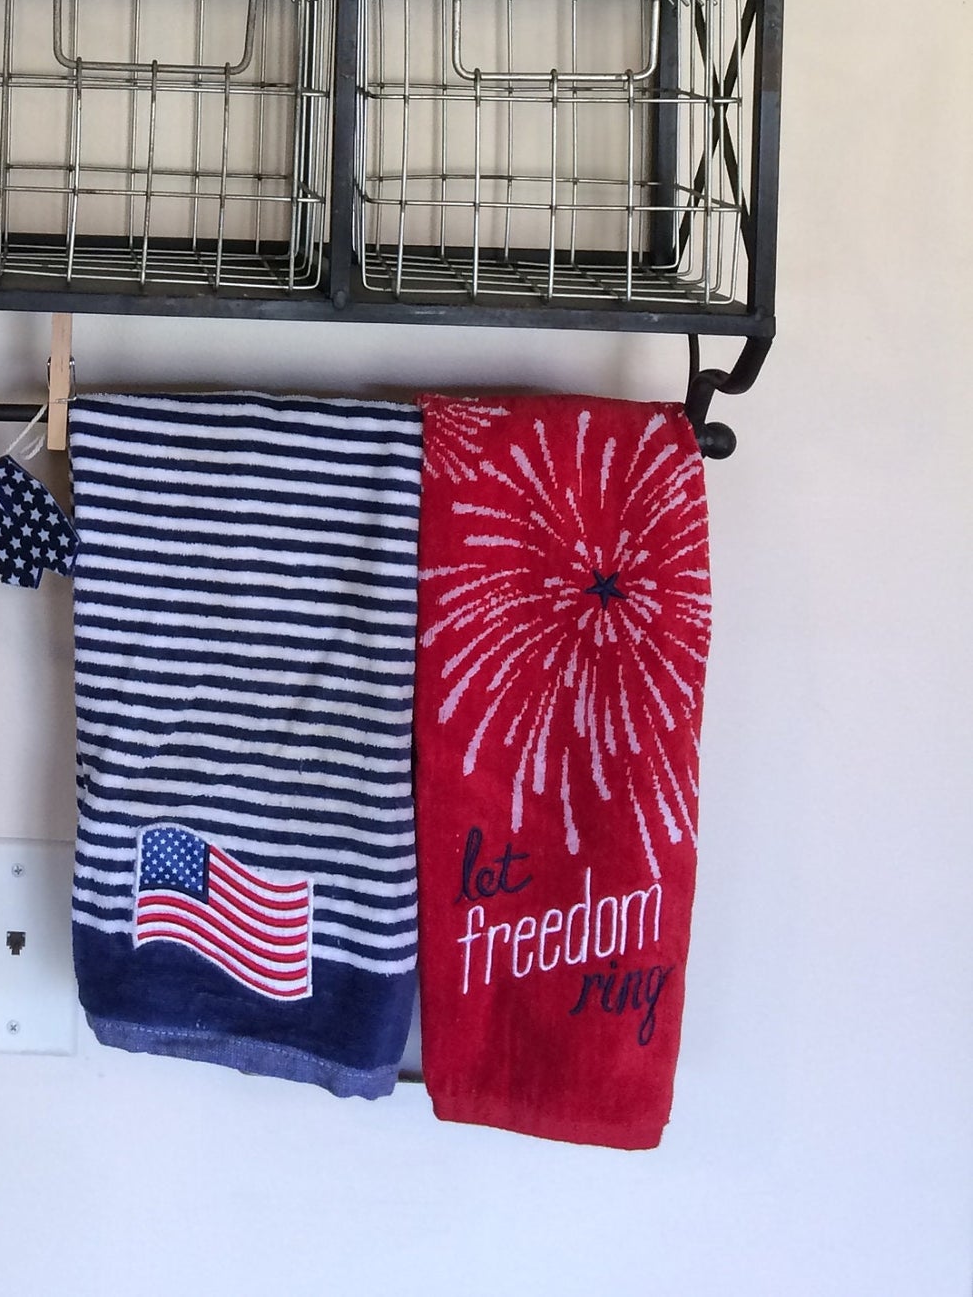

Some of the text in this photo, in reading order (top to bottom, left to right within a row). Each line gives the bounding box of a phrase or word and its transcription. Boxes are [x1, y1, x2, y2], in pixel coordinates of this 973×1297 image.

[455, 825, 532, 903] let
[456, 867, 664, 994] freedom
[568, 960, 676, 1046] ring
